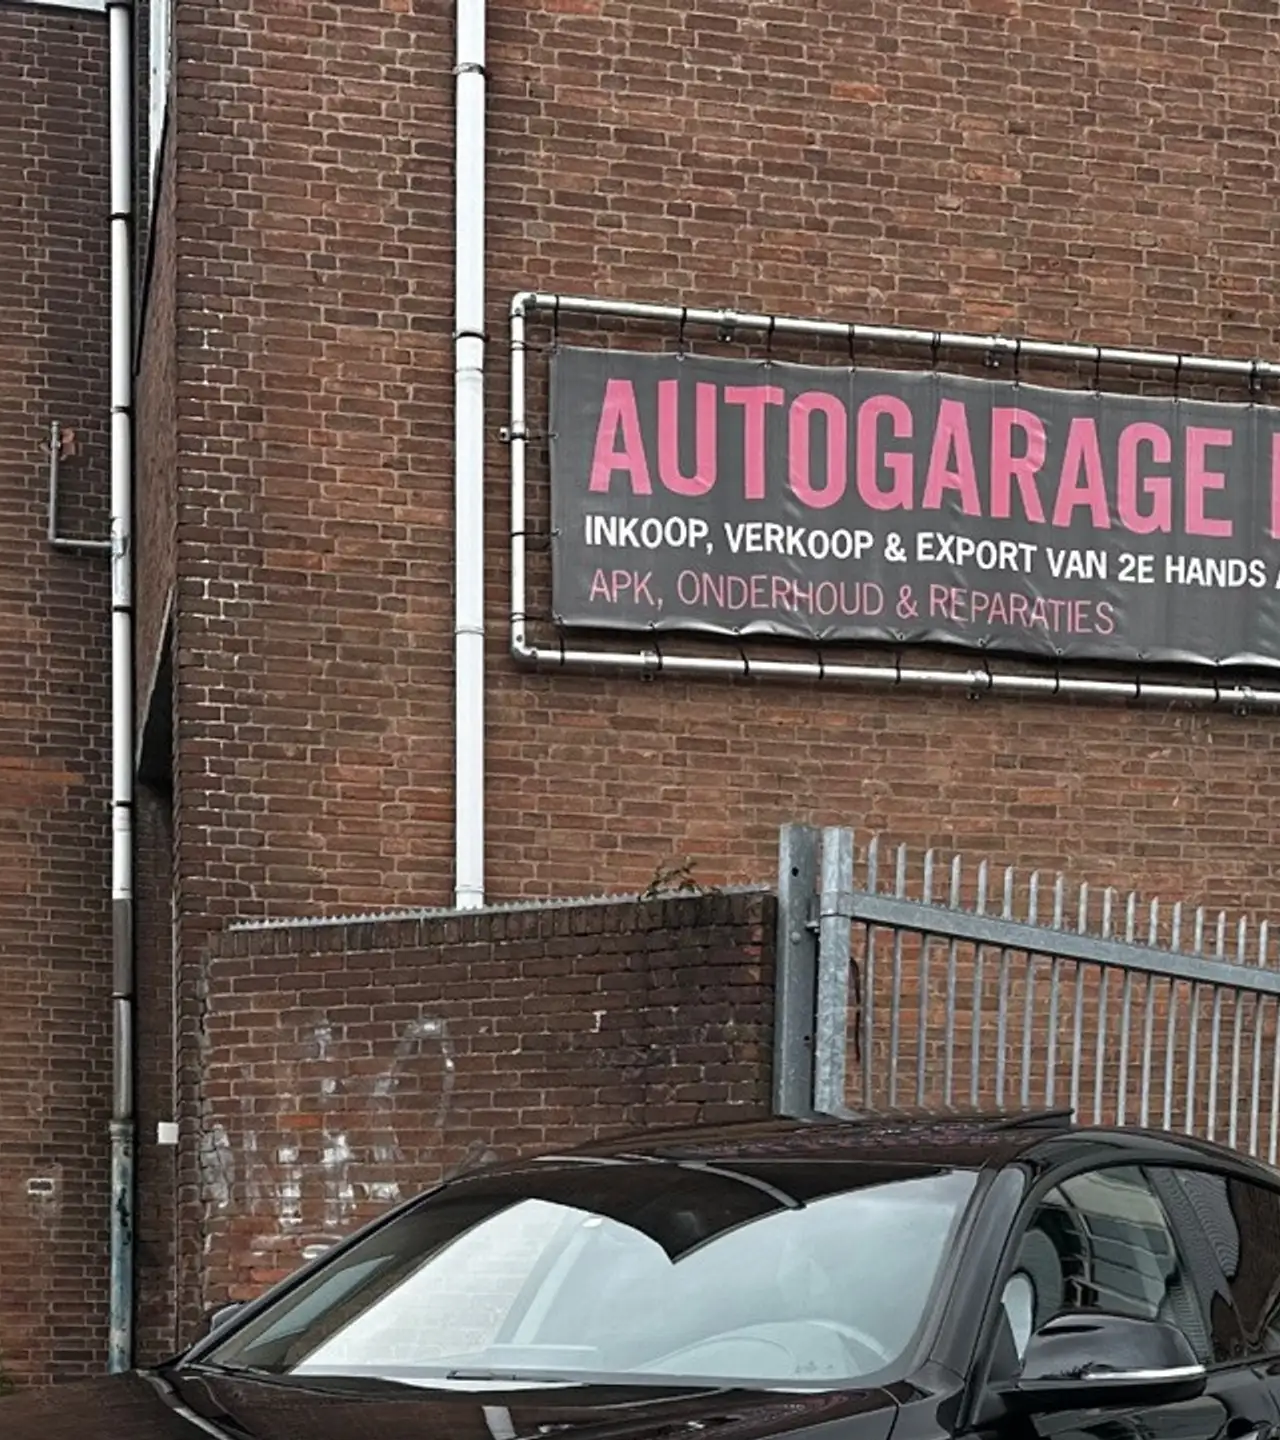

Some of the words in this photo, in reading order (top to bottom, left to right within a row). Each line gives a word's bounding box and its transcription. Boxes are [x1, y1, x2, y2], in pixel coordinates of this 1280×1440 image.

[588, 377, 1234, 538] AUTOGARAGE
[584, 514, 714, 558] INKOOP,
[724, 523, 874, 561] VERKOOP
[884, 533, 908, 562] &
[917, 532, 1038, 573] EXPORT
[1046, 548, 1109, 580] VAN
[1118, 553, 1156, 584] 2E
[1164, 555, 1267, 589] HANDS
[589, 568, 665, 612] APK,
[677, 569, 885, 618] ONDERHOUD
[896, 585, 920, 619] &
[929, 584, 1117, 636] REPARATIES
